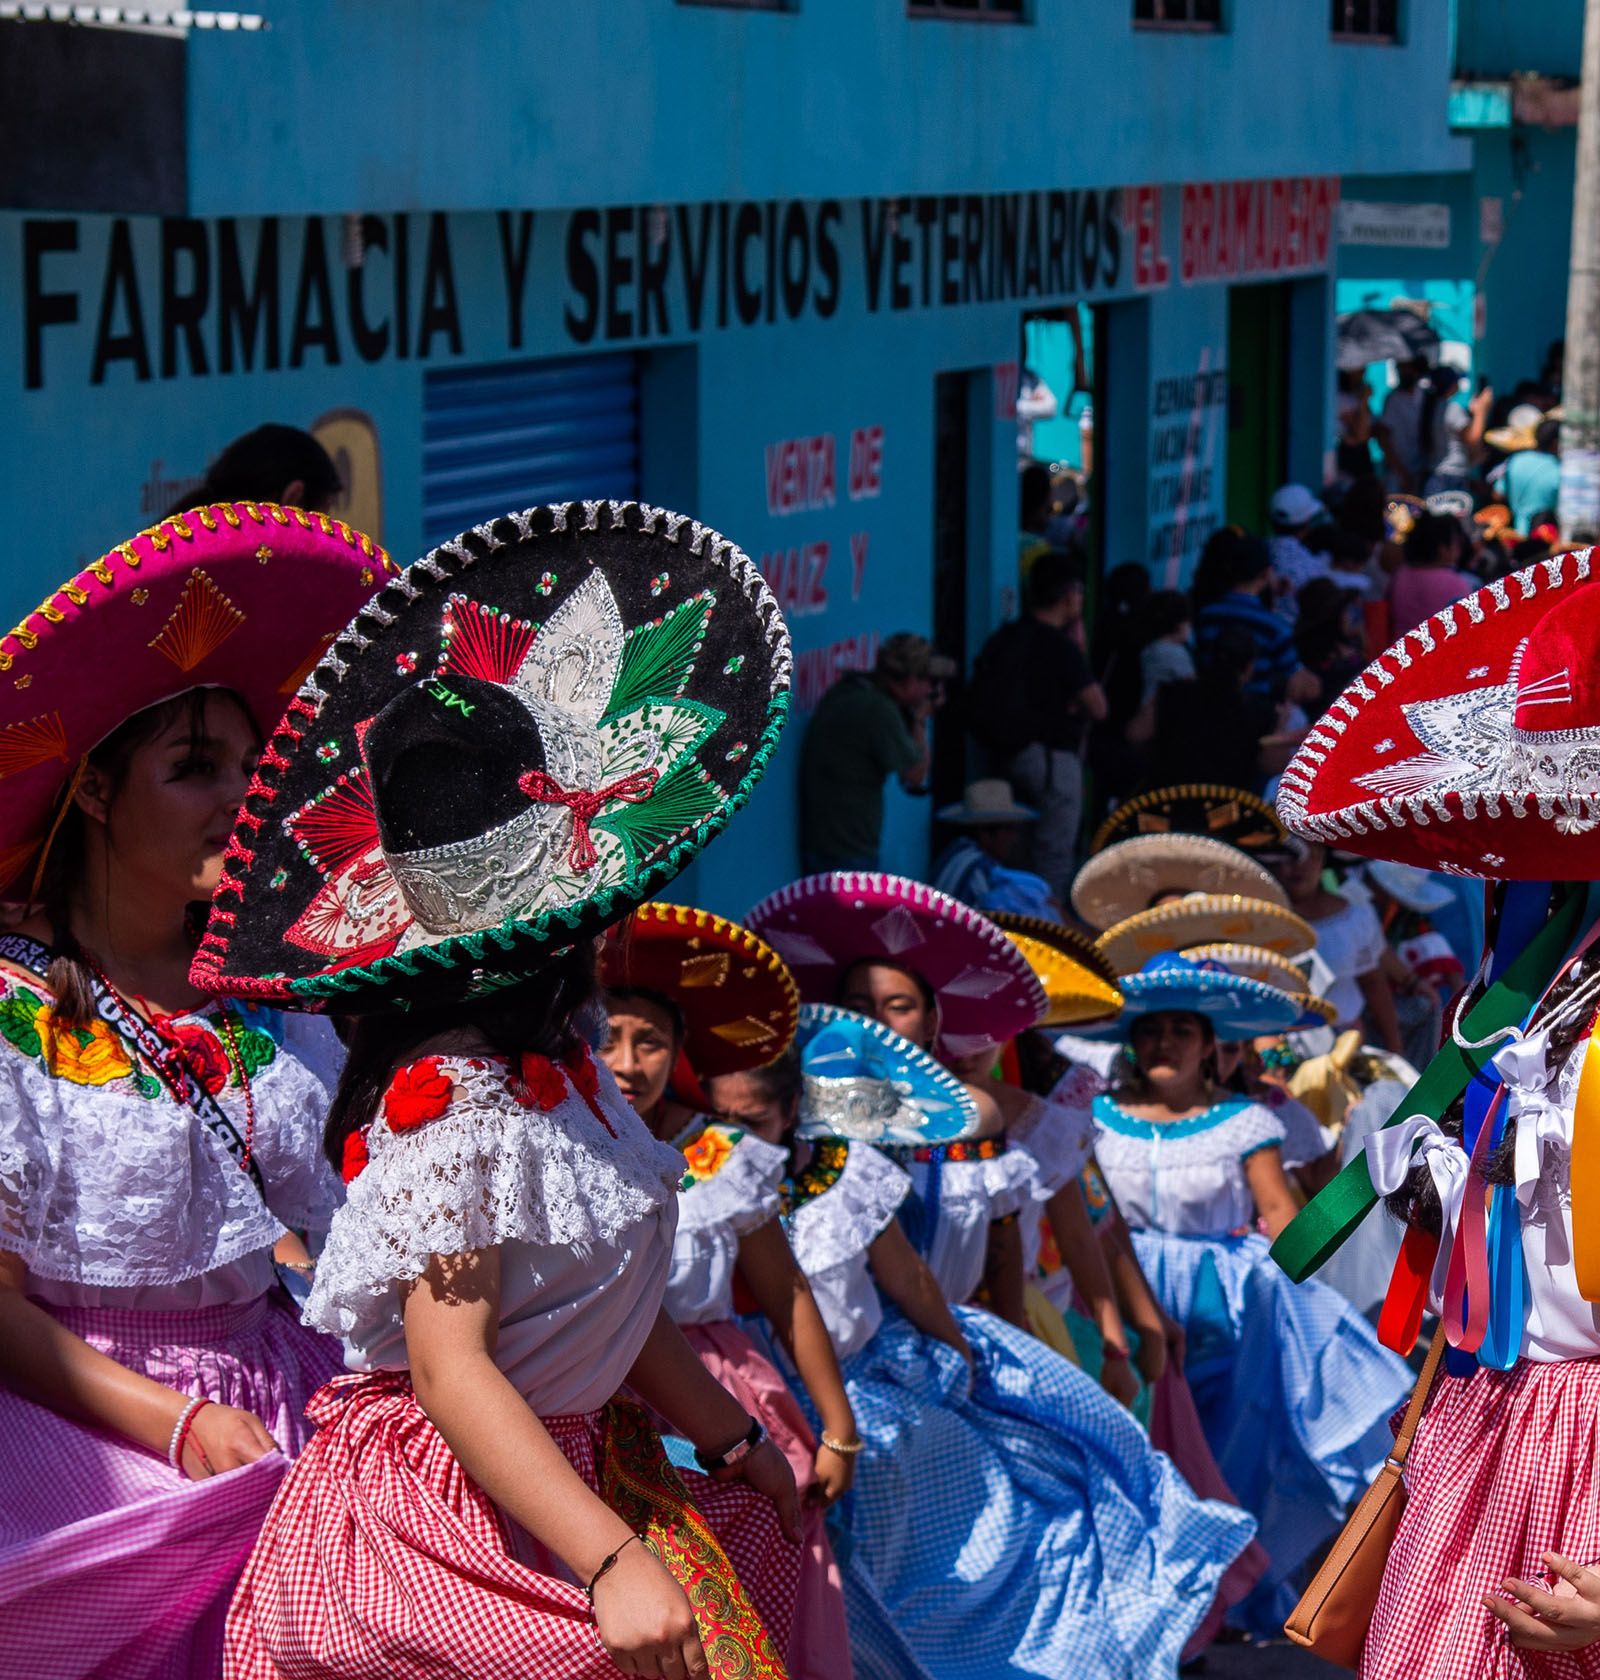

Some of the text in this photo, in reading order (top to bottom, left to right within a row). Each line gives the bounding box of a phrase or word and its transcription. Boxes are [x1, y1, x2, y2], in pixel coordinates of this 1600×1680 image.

[23, 211, 463, 389] FARMACIA
[497, 209, 534, 349] Y
[564, 200, 842, 343] SERVICIOS
[861, 187, 1122, 313] VETERINARIOS
[765, 424, 886, 516] VENTA DE
[850, 531, 870, 601] Y
